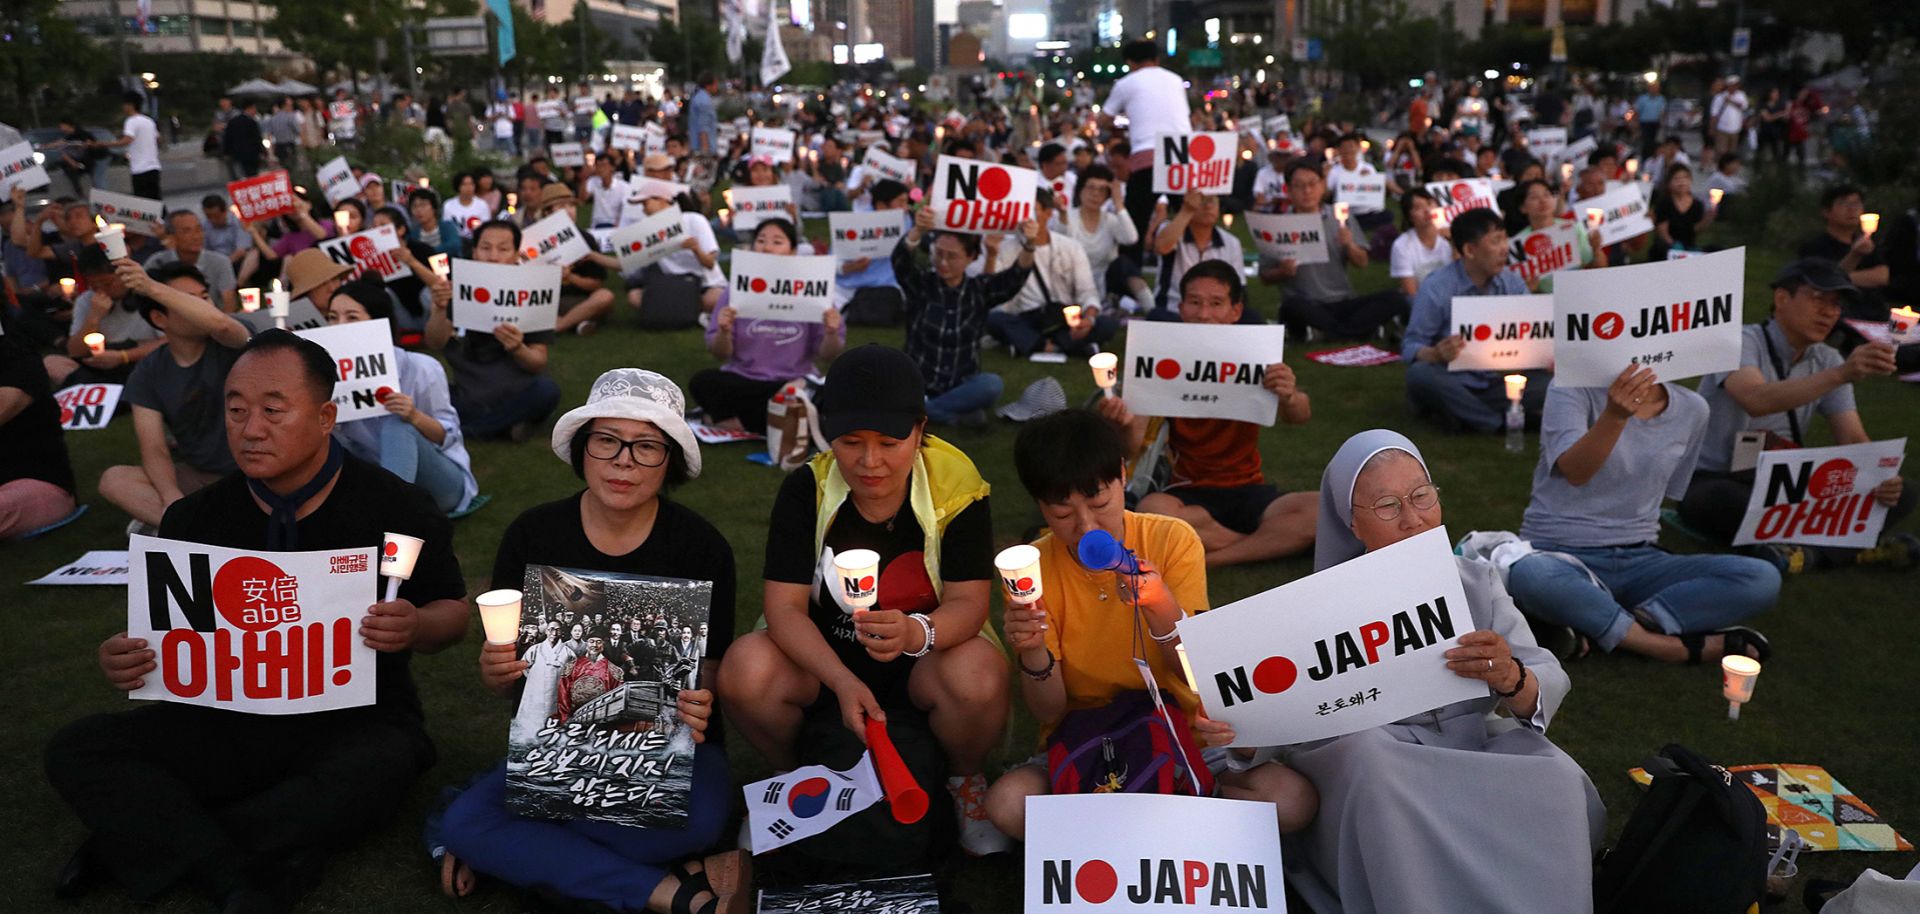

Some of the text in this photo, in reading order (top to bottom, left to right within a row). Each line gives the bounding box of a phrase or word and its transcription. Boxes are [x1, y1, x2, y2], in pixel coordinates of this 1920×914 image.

[1163, 134, 1216, 165] NO
[946, 163, 1012, 202] NO
[1167, 159, 1232, 191] 아베!
[945, 198, 1030, 231] 아베!
[538, 226, 576, 254] JAPAN
[620, 240, 643, 257] NO
[645, 222, 684, 248] JAPAN
[836, 225, 900, 241] NO JAPAN
[1276, 230, 1320, 245] JAPAN
[460, 284, 553, 308] NO JAPAN
[737, 274, 828, 297] NO JAPAN
[1459, 320, 1554, 341] NO JAPAN
[1567, 293, 1733, 342] NO JAHAN
[334, 353, 388, 382] PAN
[1135, 356, 1268, 385] NO JAPAN
[1764, 457, 1857, 508] NO
[1754, 491, 1877, 541] 아베!
[329, 563, 368, 574] 시민행동
[330, 553, 368, 565] 아베규탄
[145, 550, 294, 633] NO
[242, 573, 299, 604] 安倍
[843, 576, 875, 593] NO
[1002, 577, 1034, 592] NO
[242, 601, 302, 625] abe
[162, 616, 352, 702] 아베!
[1214, 596, 1456, 708] NO JAPAN
[1315, 687, 1382, 716] 본토왜구
[525, 748, 608, 781] 일본에
[569, 777, 666, 809] 않는다
[1043, 859, 1269, 909] NO JAPAN
